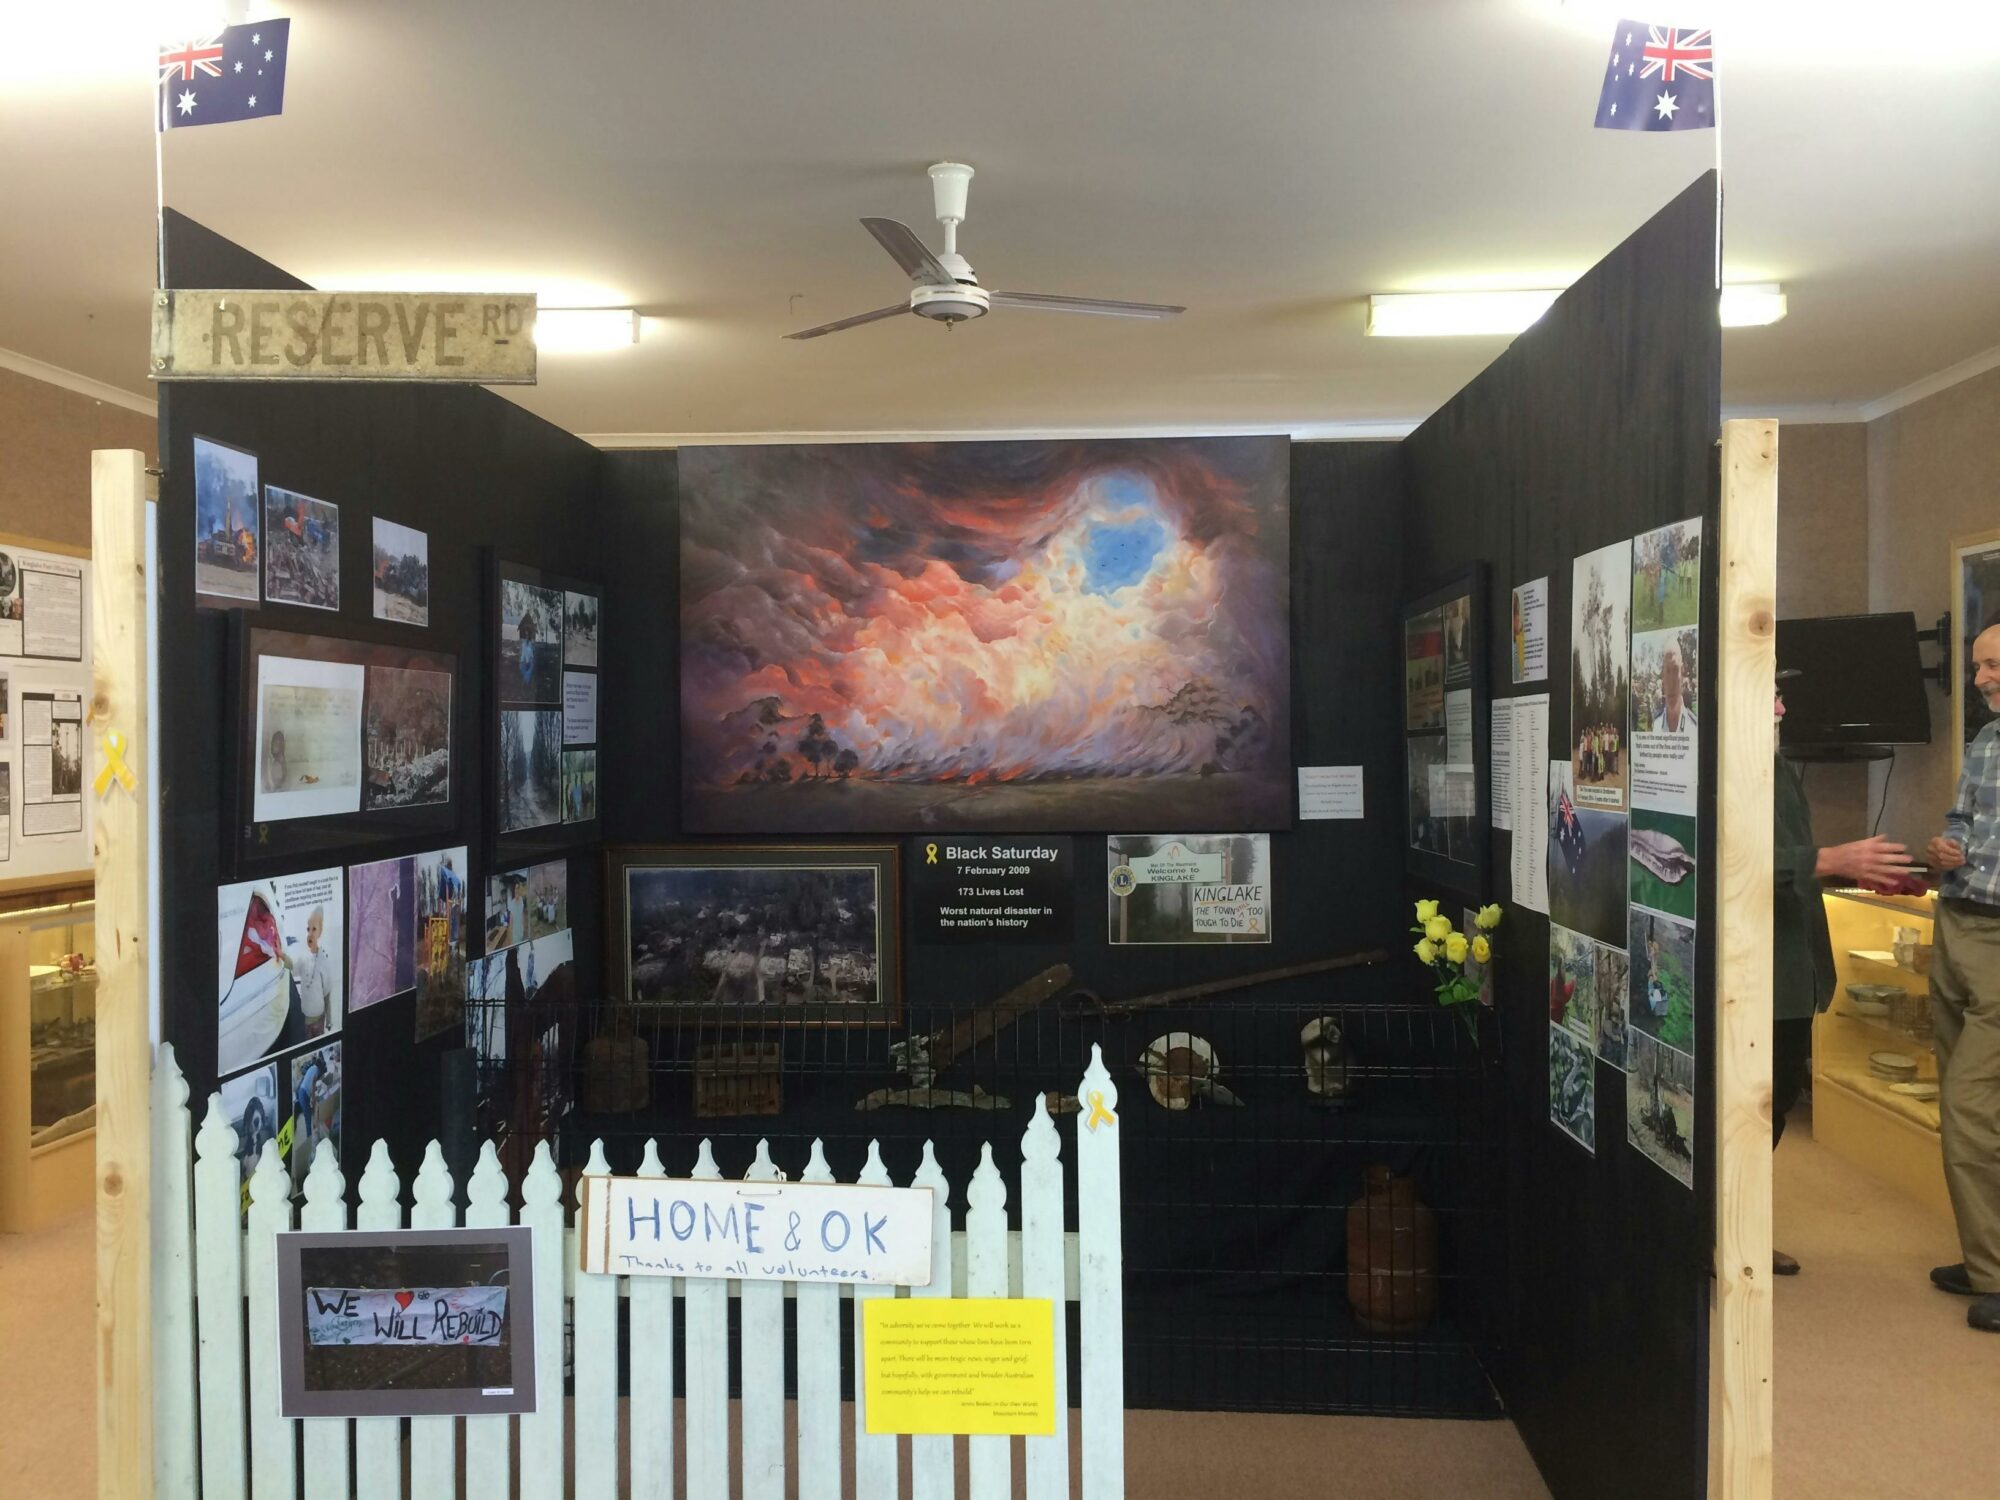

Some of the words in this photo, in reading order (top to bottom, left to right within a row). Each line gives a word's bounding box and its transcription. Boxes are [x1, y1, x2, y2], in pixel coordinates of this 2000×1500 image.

[211, 302, 465, 366] RESERVE
[482, 303, 523, 337] RD
[946, 847, 987, 859] Black
[992, 846, 1058, 861] Saturday
[957, 866, 962, 874] 7
[965, 866, 1006, 876] February
[1008, 866, 1030, 874] 2009
[958, 888, 974, 896] 173
[976, 888, 1001, 896] Lives
[1003, 888, 1024, 896] Lost
[1193, 886, 1263, 902] KINGLAKE
[940, 907, 967, 915] Worst
[970, 907, 1002, 915] natural
[1004, 907, 1041, 915] disaster
[1043, 907, 1052, 915] in
[1195, 906, 1210, 915] THE
[1214, 905, 1236, 915] TOWN
[1248, 906, 1263, 916] TOO
[940, 919, 955, 927] the
[957, 918, 994, 927] nation's
[996, 919, 1028, 928] history
[1195, 919, 1217, 927] TOUGH
[628, 1196, 765, 1253] HOME
[784, 1211, 801, 1251] &
[820, 1210, 887, 1255] OK
[619, 1255, 685, 1272] Thanks
[694, 1261, 712, 1272] to
[726, 1261, 748, 1275] all
[312, 1290, 360, 1317] WE
[373, 1307, 426, 1340] WILL
[432, 1299, 502, 1342] REBUILD
[920, 1339, 942, 1347] support
